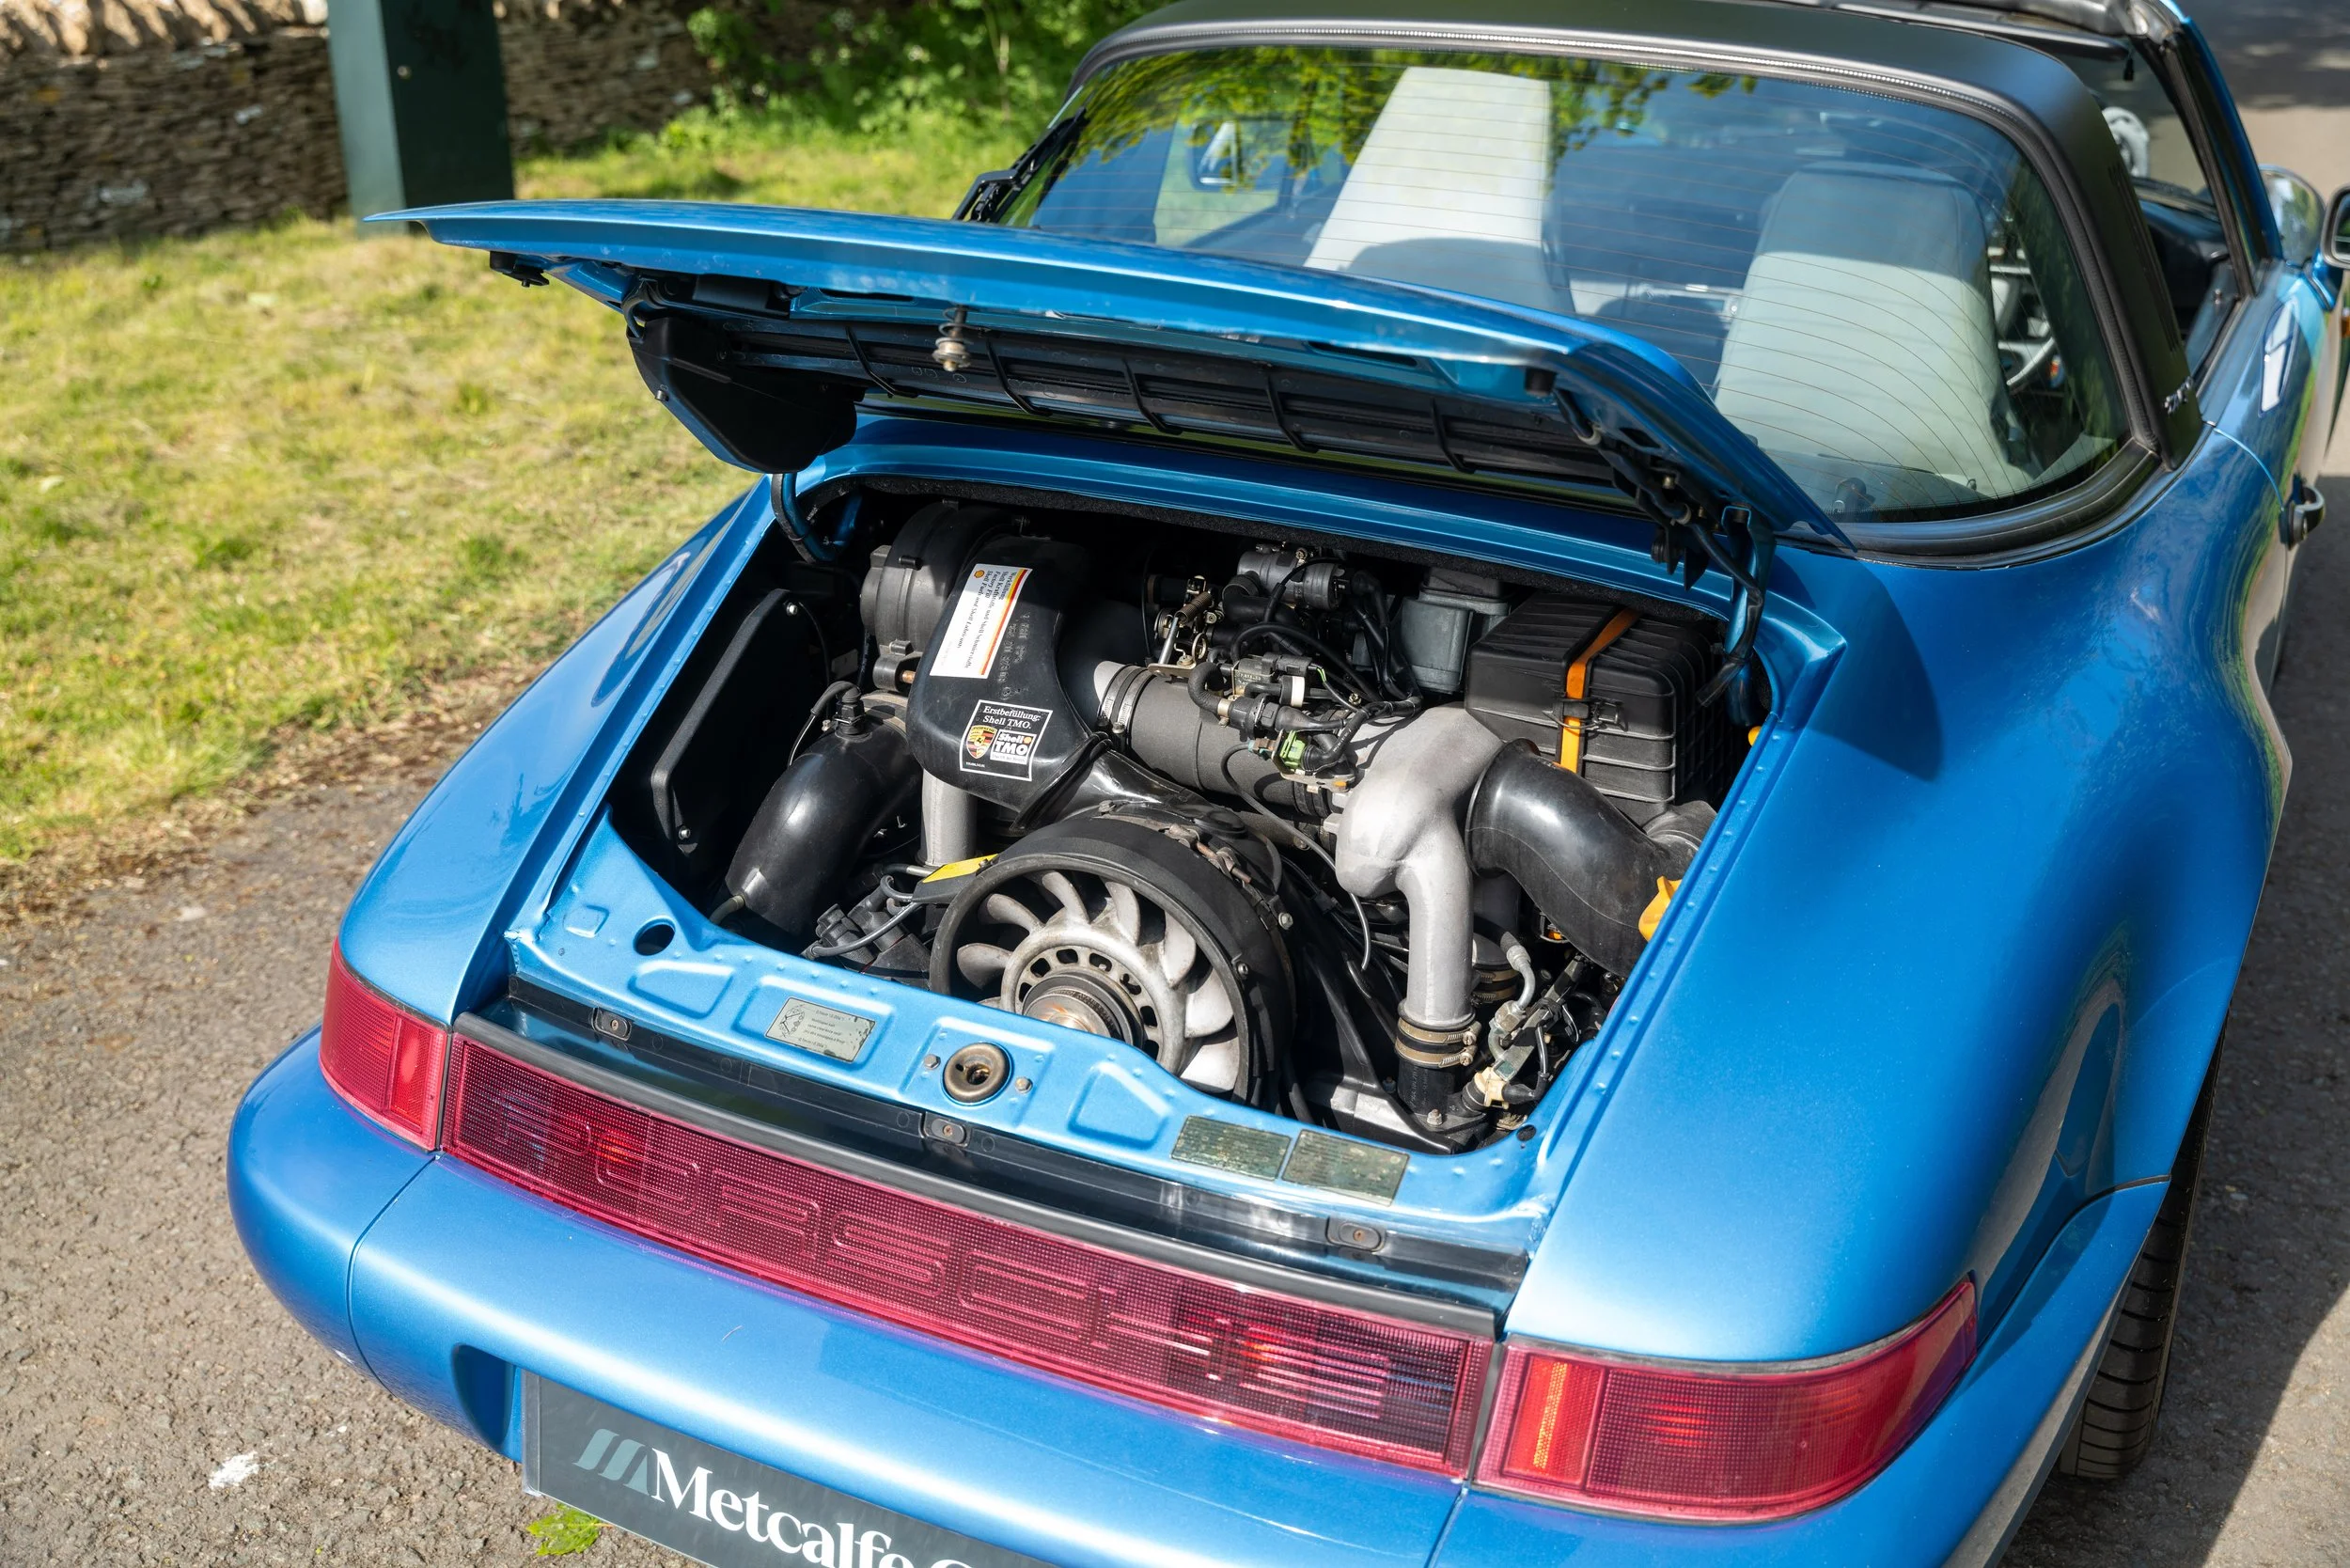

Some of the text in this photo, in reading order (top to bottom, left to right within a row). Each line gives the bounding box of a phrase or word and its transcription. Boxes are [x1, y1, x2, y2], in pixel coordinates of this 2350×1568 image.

[983, 570, 994, 582] Shell
[988, 571, 1001, 588] Factory
[1000, 571, 1009, 582] Shell
[982, 715, 1031, 729] Shell TMO.
[997, 733, 1024, 744] Shell
[995, 741, 1028, 756] TMO
[495, 1091, 1389, 1419] PORSCHE
